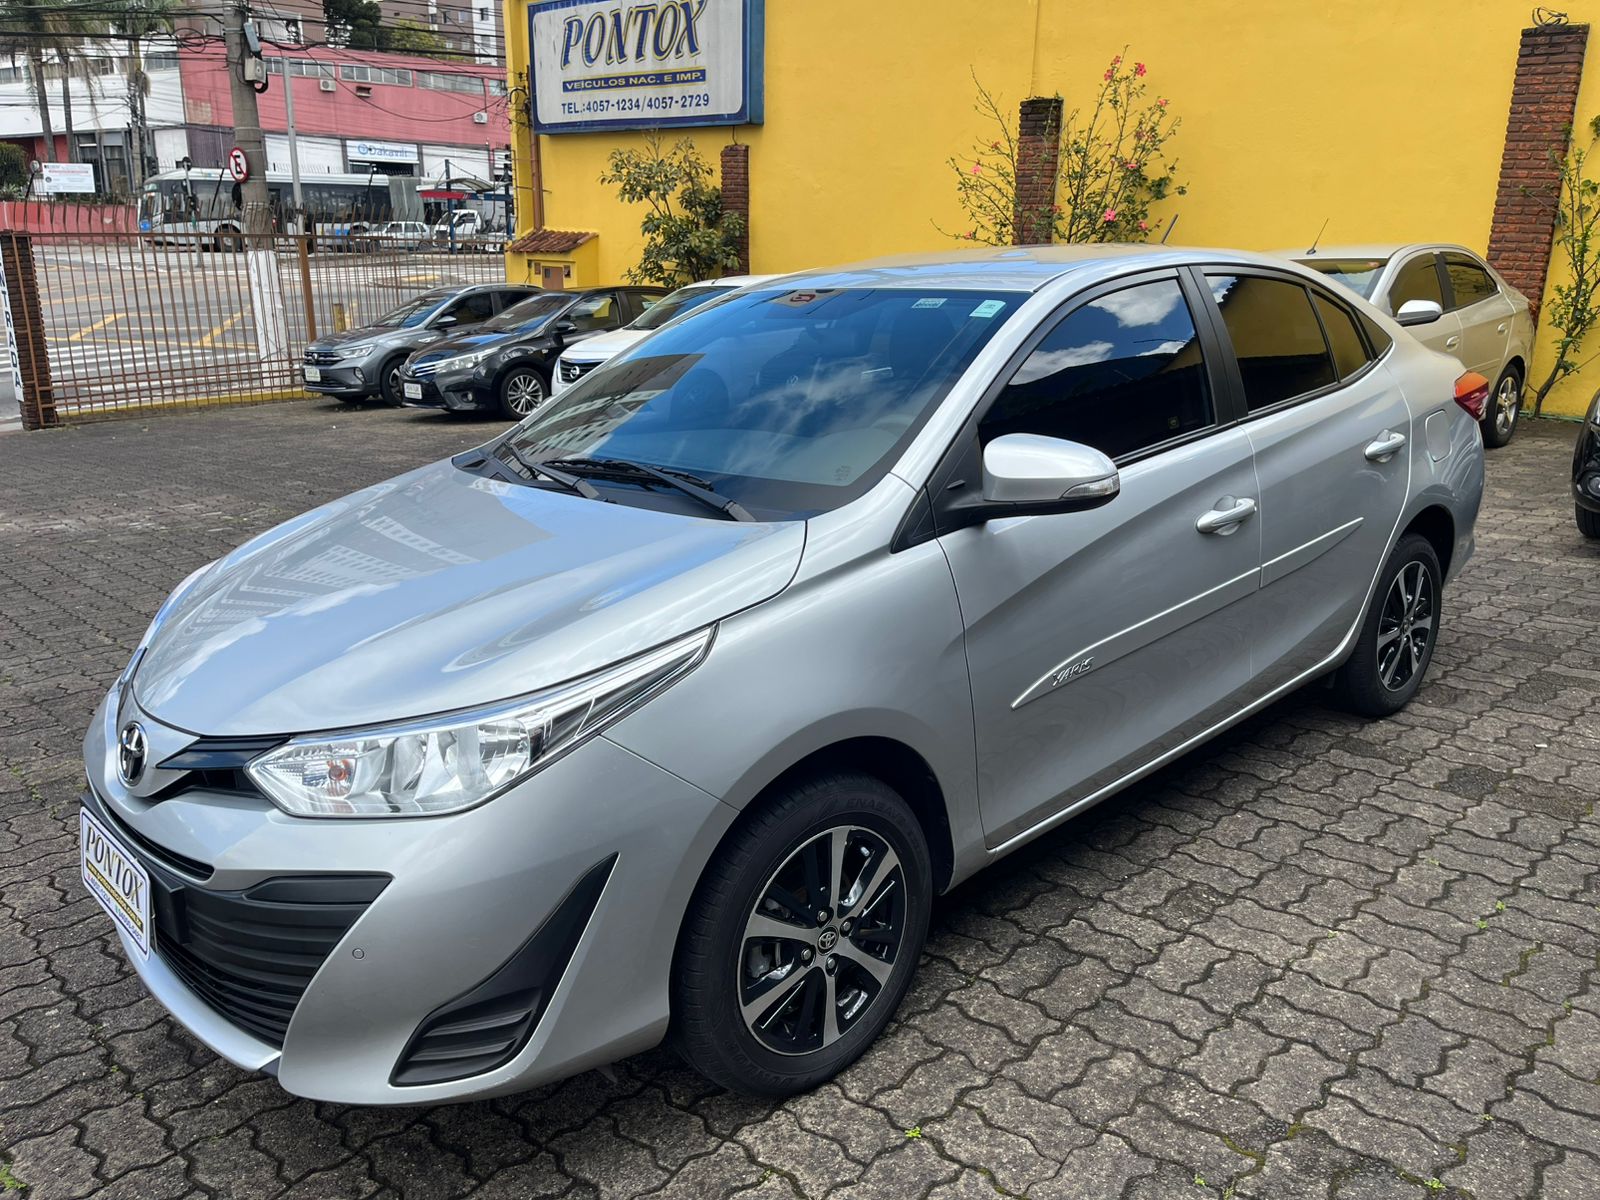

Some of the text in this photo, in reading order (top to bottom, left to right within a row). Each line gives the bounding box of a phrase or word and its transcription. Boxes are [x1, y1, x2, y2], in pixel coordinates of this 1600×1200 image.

[561, 0, 707, 70] PONTOX
[629, 75, 660, 85] NAC.
[664, 74, 672, 82] E
[676, 72, 703, 82] IMP.
[85, 824, 143, 912] PONTOX
